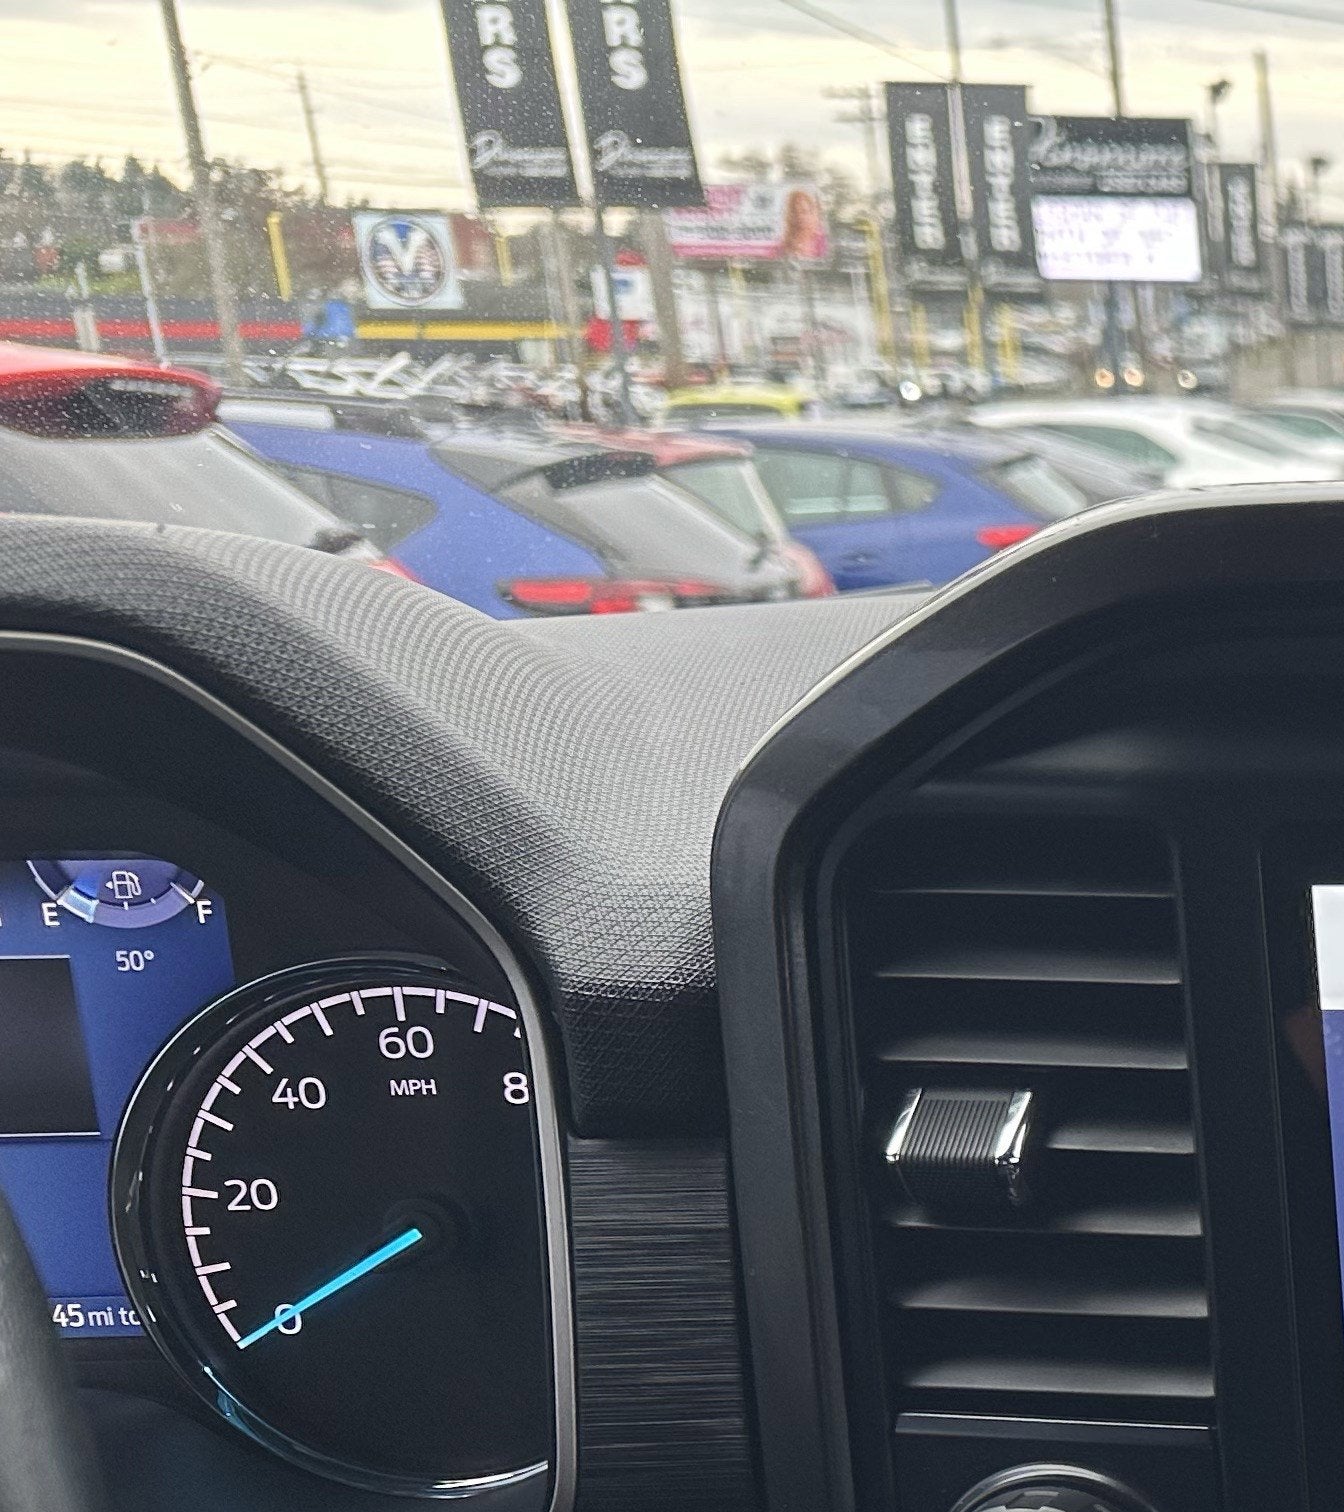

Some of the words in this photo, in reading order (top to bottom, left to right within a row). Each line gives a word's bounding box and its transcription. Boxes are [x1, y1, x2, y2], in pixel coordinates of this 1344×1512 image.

[41, 902, 61, 926] E
[197, 900, 212, 923] F
[116, 950, 154, 971] 50°
[379, 1026, 433, 1058] 60
[272, 1077, 326, 1109] 40
[390, 1079, 436, 1095] MPH
[225, 1179, 278, 1210] 20
[52, 1303, 85, 1328] 45
[87, 1306, 115, 1327] mi
[275, 1303, 302, 1335] 0
